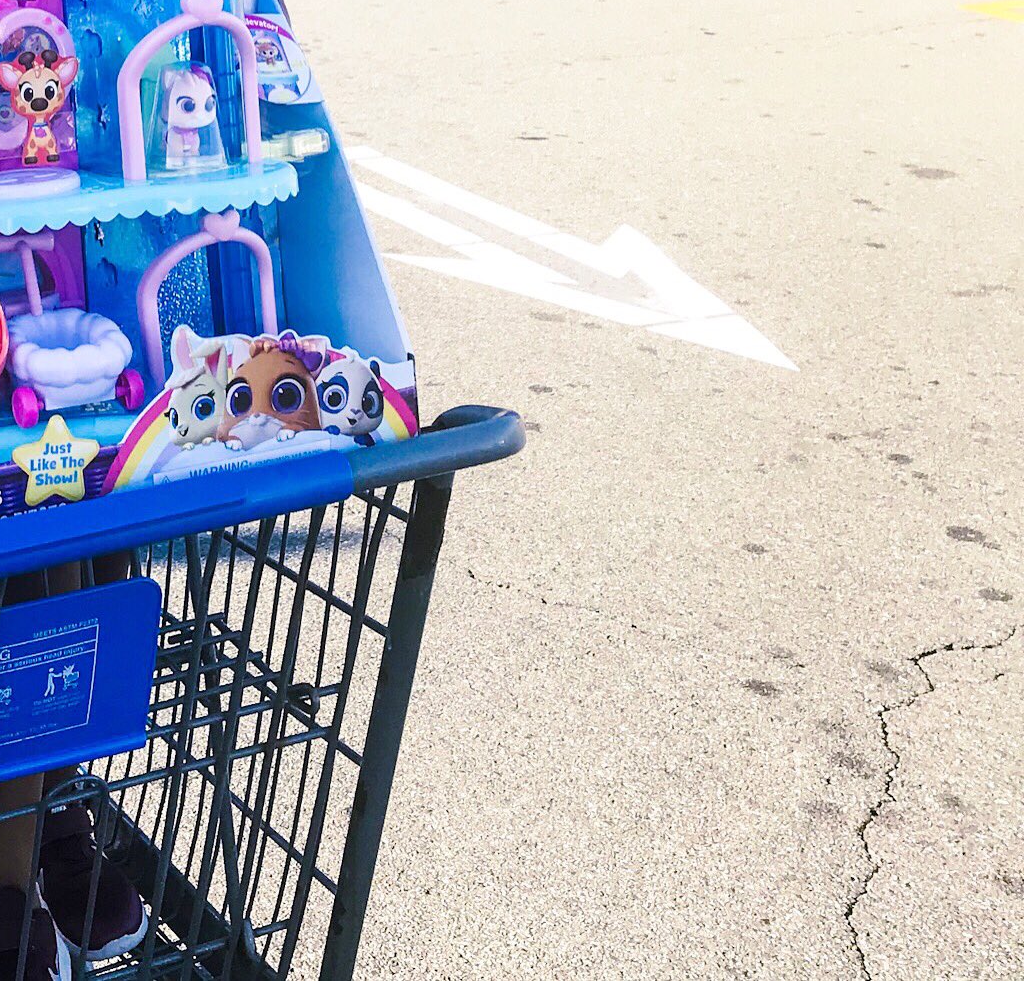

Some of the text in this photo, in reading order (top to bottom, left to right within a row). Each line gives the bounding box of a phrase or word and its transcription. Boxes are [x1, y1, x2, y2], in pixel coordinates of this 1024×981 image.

[43, 442, 72, 455] Just
[30, 456, 85, 471] Like The
[35, 470, 79, 486] Show!
